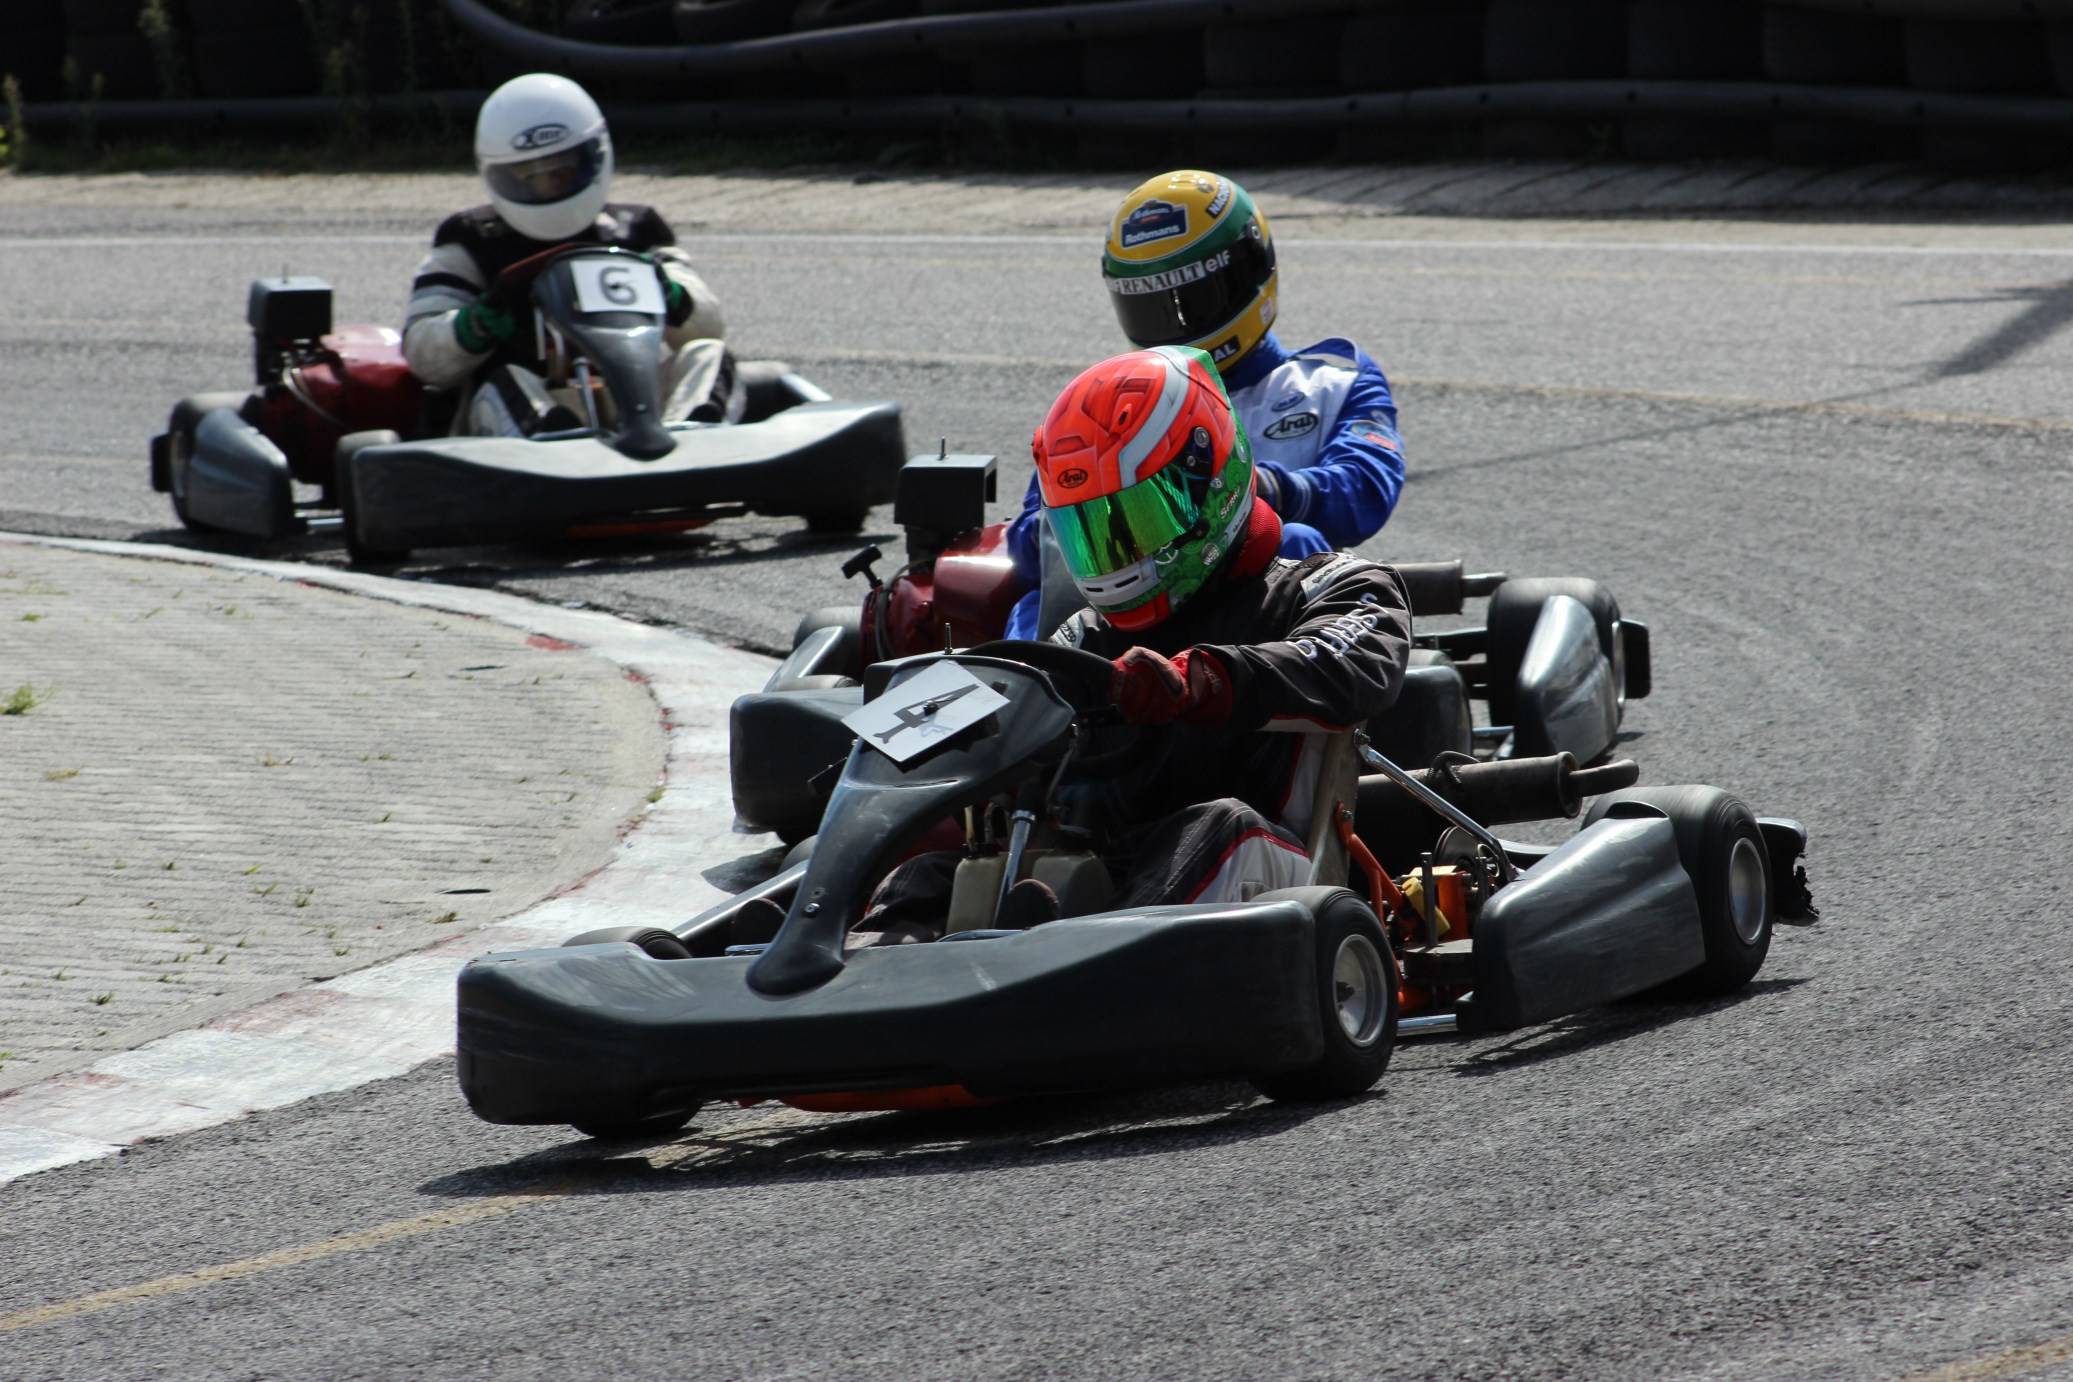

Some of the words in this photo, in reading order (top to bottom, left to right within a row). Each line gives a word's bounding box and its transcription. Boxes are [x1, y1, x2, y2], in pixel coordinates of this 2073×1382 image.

[1125, 224, 1180, 245] Rothmans
[599, 266, 637, 306] 6
[1121, 263, 1202, 294] RENAULT
[1213, 343, 1236, 362] AL
[1264, 415, 1315, 437] Arai
[1059, 470, 1084, 486] Arai
[873, 684, 980, 744] 4
